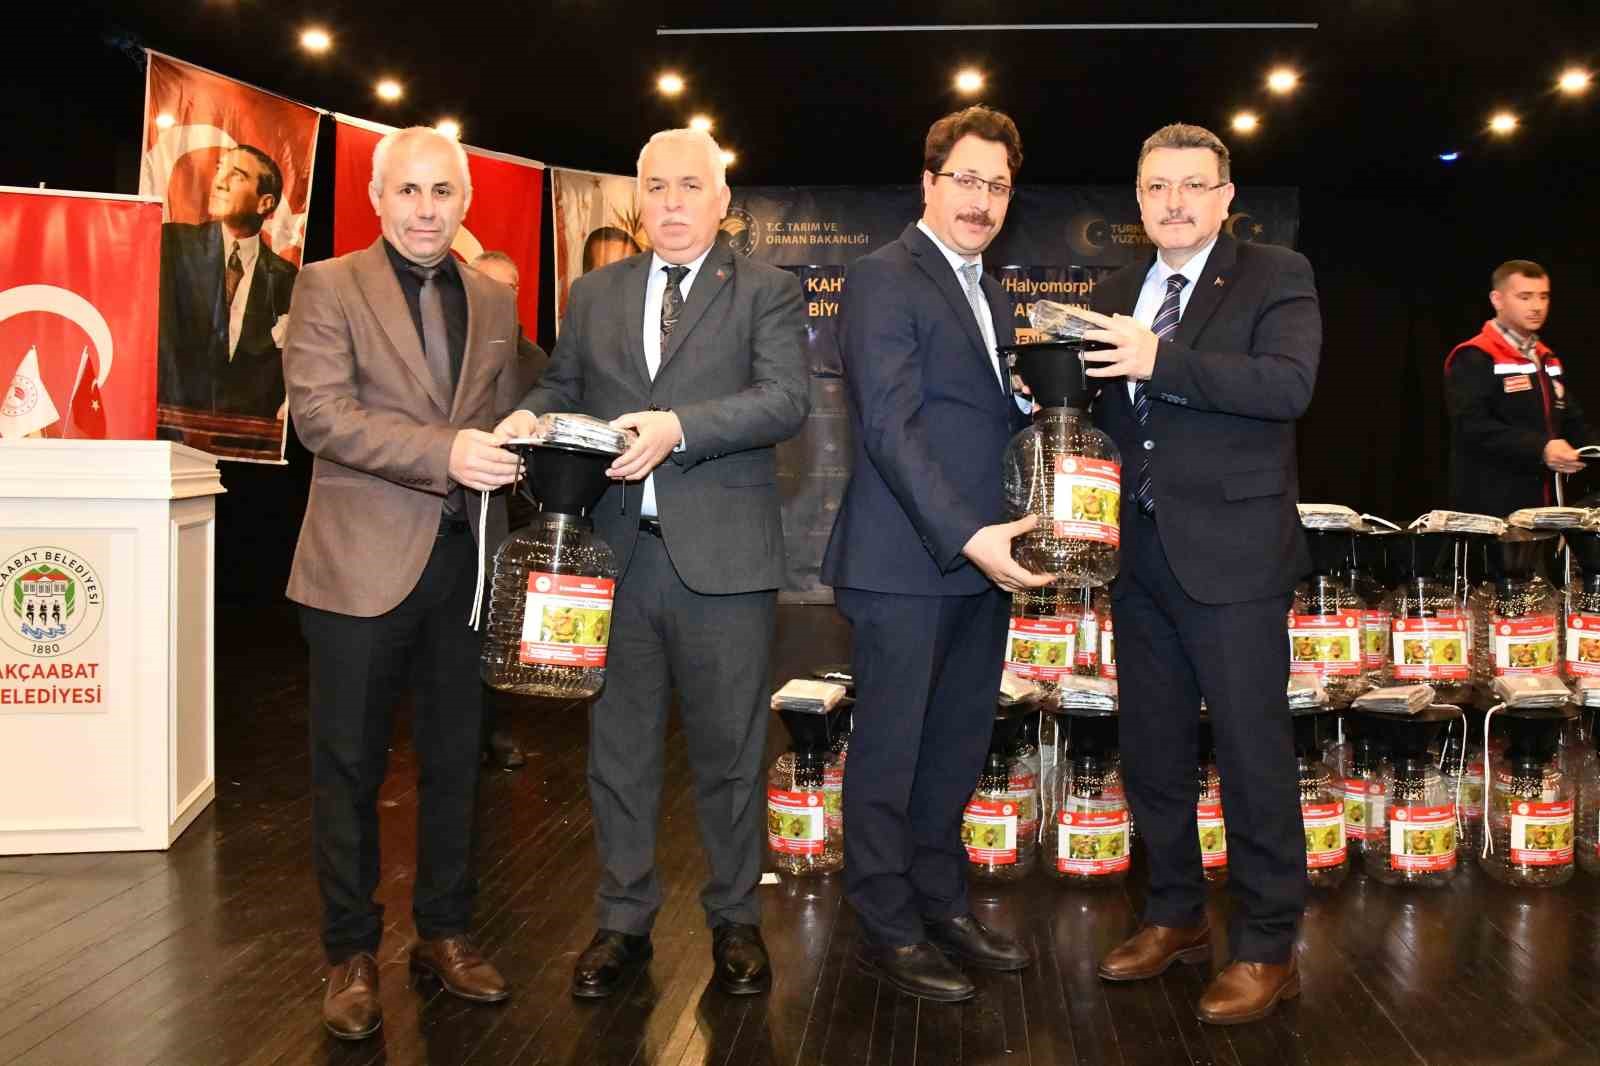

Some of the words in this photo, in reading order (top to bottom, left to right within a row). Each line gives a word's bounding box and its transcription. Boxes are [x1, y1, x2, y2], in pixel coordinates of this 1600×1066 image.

[788, 222, 821, 232] TARIM
[823, 222, 838, 232] VE
[766, 233, 807, 244] ORMAN
[809, 232, 869, 244] BAKANLIĞI
[807, 277, 845, 292] KAH
[0, 552, 38, 589] AABAT
[32, 643, 60, 654] 1880
[0, 685, 102, 704] ELEDİYESİ
